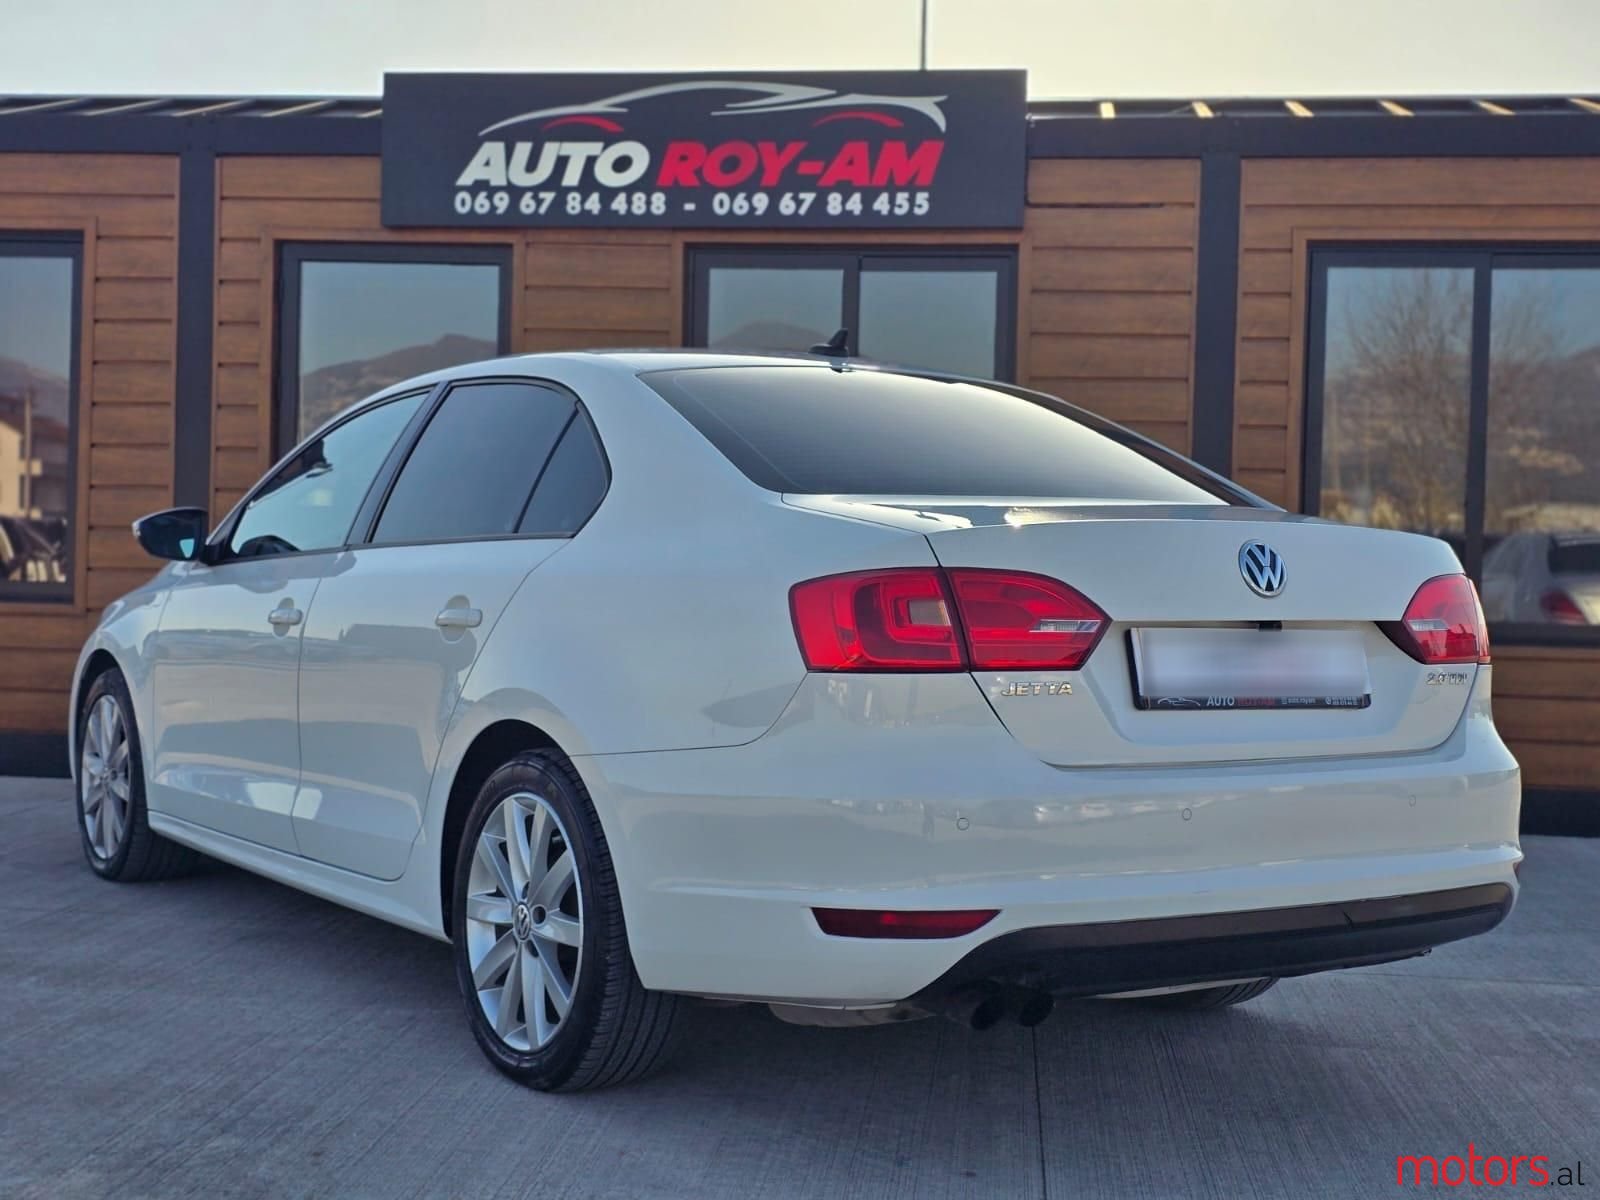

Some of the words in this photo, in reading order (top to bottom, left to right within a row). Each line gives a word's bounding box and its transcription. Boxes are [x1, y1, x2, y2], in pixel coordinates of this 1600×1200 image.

[455, 140, 650, 188] AUTO
[656, 140, 945, 188] ROY-AM
[454, 191, 510, 215] 069
[519, 191, 557, 215] 67
[565, 191, 602, 215] 84
[610, 191, 667, 215] 488
[712, 192, 769, 216] 069
[778, 192, 817, 216] 67
[826, 192, 863, 216] 84
[872, 192, 931, 216] 455
[1001, 681, 1073, 696] JETTA
[1206, 695, 1235, 706] AUTO
